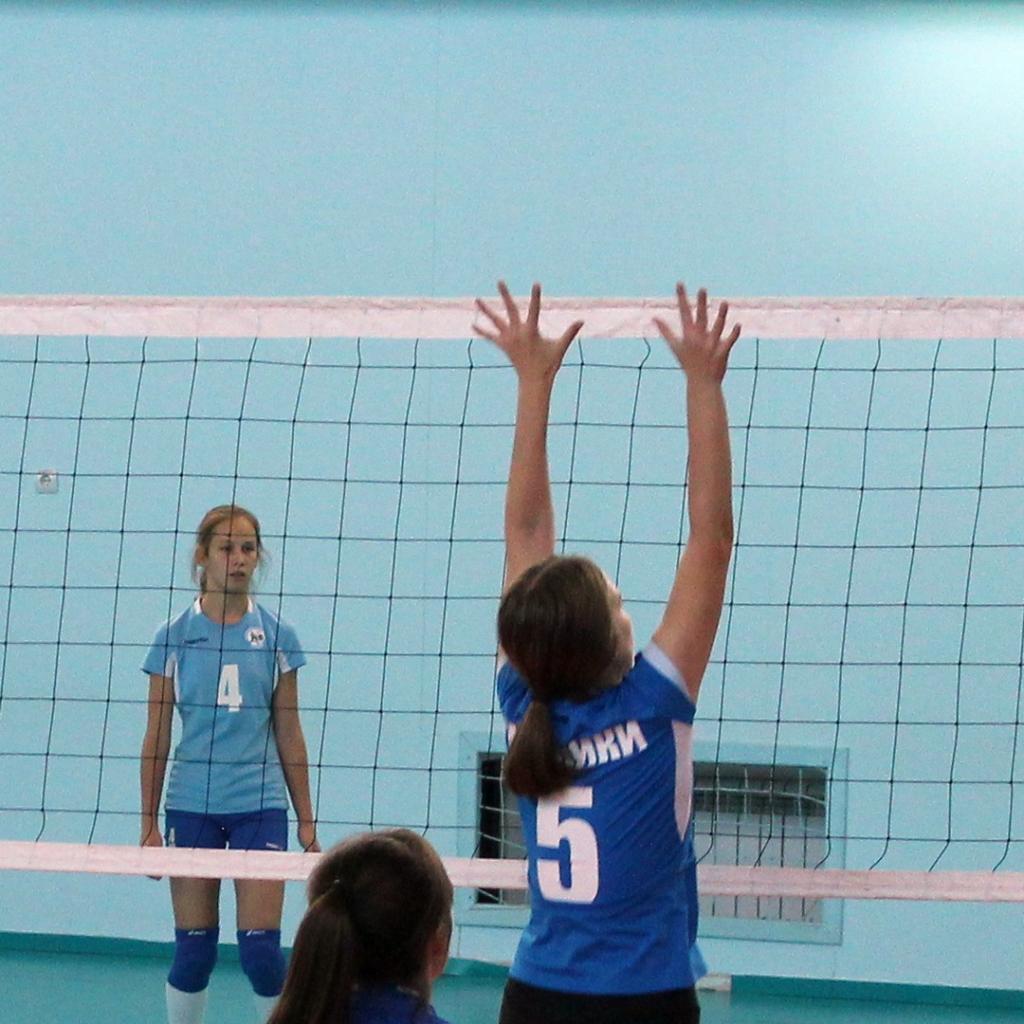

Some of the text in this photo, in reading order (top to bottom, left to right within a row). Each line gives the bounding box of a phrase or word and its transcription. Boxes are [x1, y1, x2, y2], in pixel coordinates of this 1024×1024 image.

[217, 663, 243, 712] 4
[563, 720, 648, 769] ИКИ
[536, 785, 600, 905] 5
